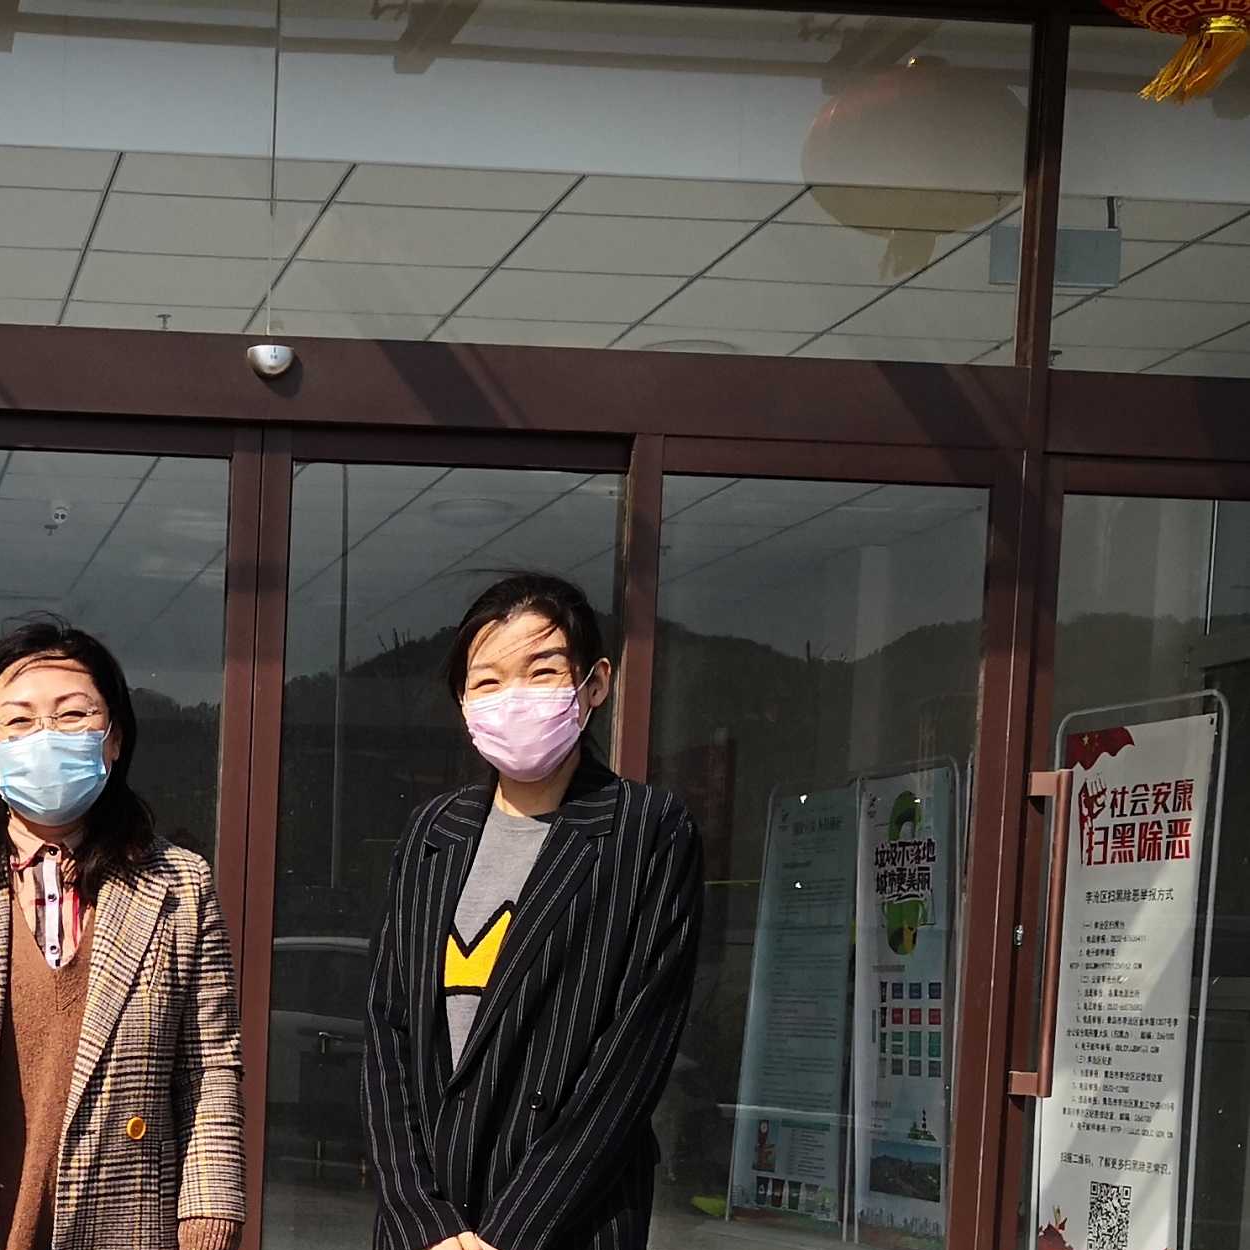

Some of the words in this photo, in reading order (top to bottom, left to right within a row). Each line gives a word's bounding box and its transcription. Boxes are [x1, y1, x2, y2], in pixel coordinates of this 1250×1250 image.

[1111, 778, 1194, 817] 社会安康
[874, 838, 937, 868] 垃圾不落地
[1086, 818, 1191, 865] 扫黑除恶
[876, 867, 931, 894] 城市更美丽
